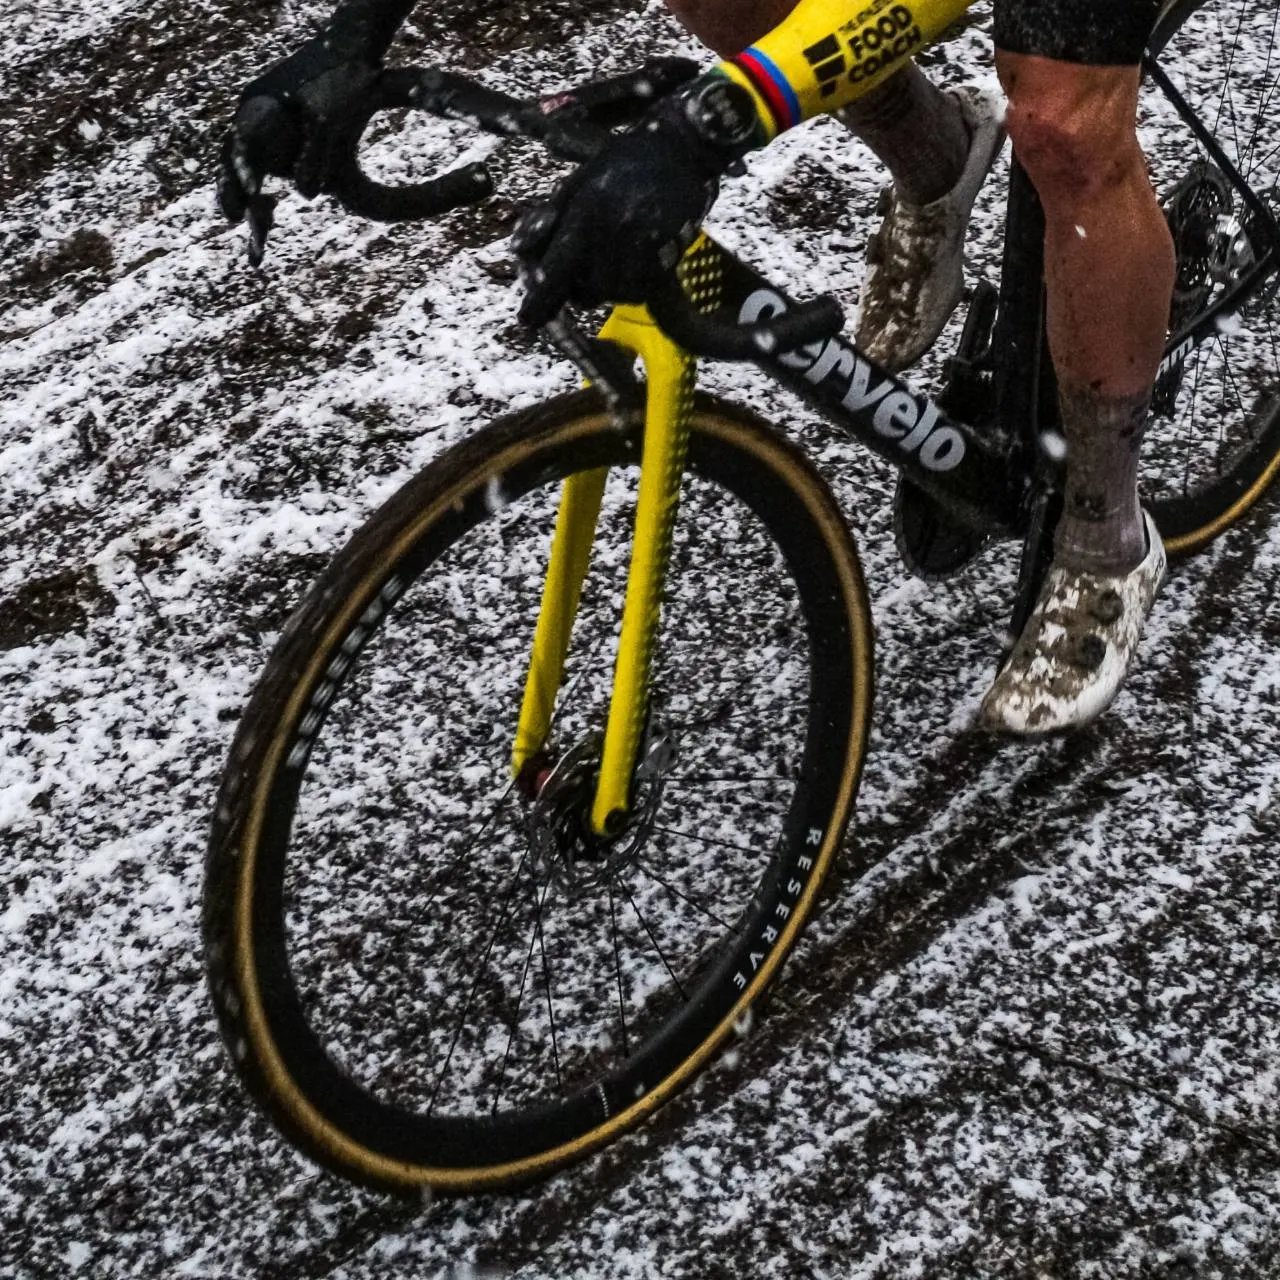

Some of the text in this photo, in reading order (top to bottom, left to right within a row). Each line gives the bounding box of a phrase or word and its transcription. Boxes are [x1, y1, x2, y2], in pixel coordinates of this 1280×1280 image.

[848, 4, 913, 60] FOOD
[848, 23, 922, 84] COACH
[732, 826, 824, 991] RESERVE
